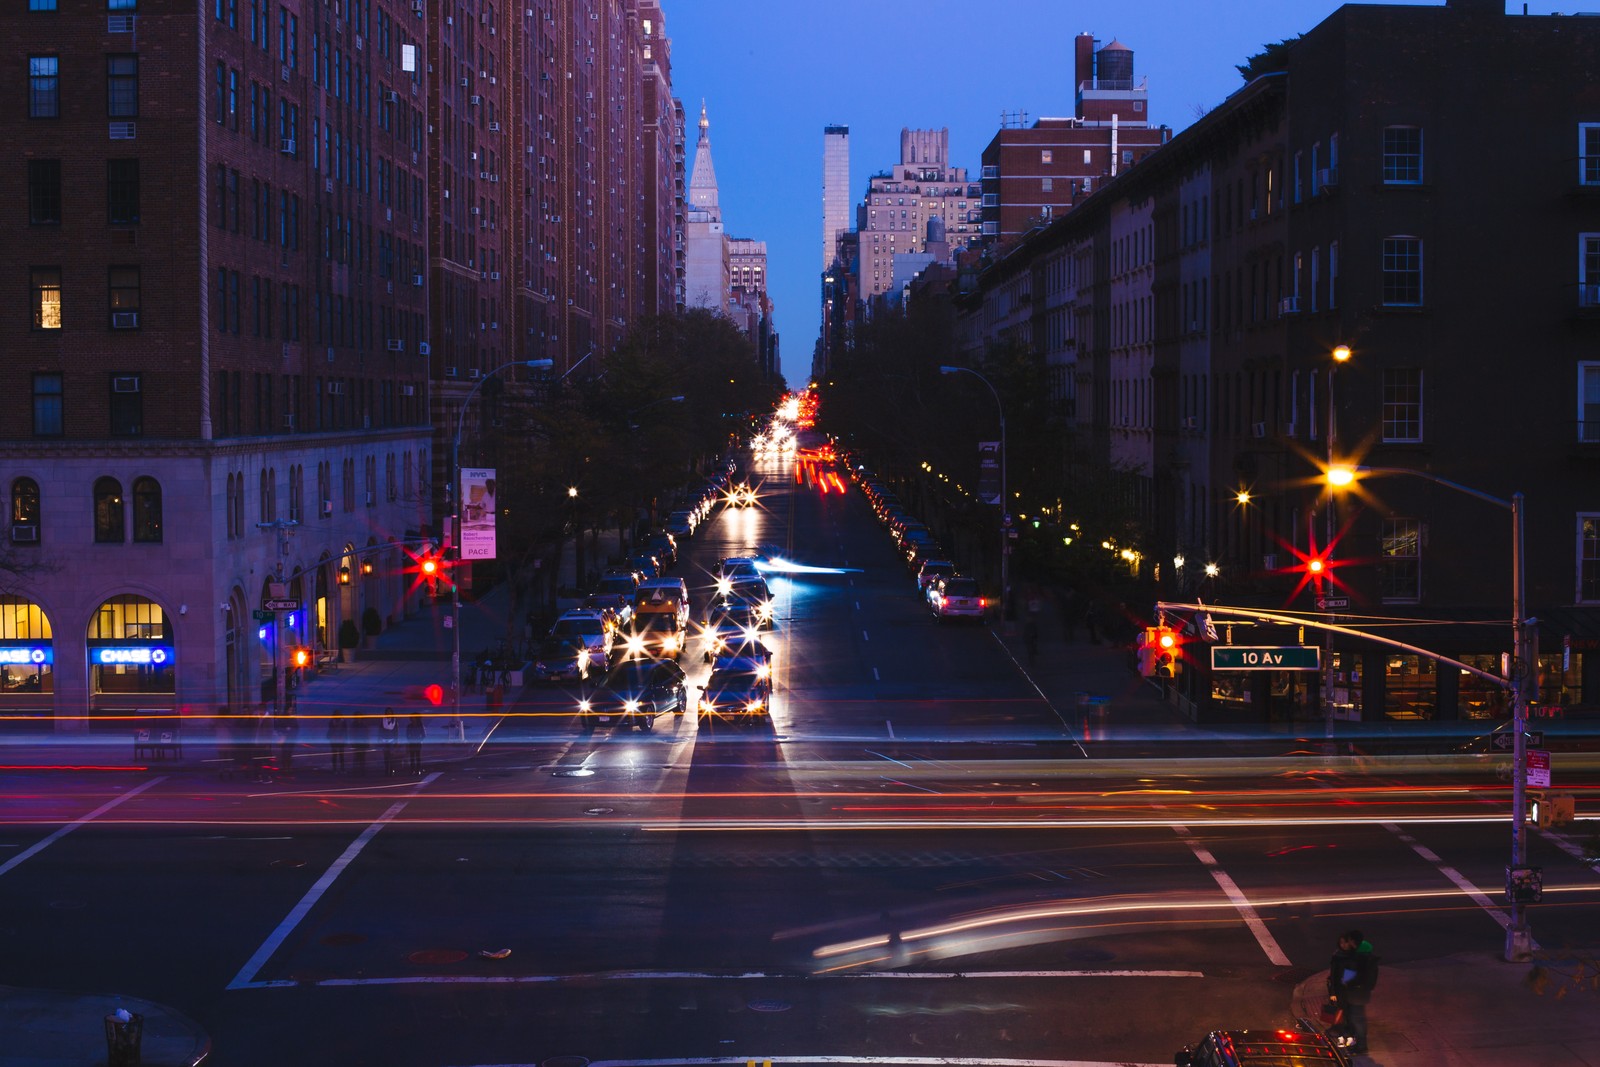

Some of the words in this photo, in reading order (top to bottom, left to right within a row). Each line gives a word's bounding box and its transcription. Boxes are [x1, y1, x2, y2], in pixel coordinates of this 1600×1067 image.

[0, 650, 30, 663] ASE
[100, 649, 151, 663] CHASE
[1242, 652, 1258, 664] 10
[1262, 652, 1283, 664] Av
